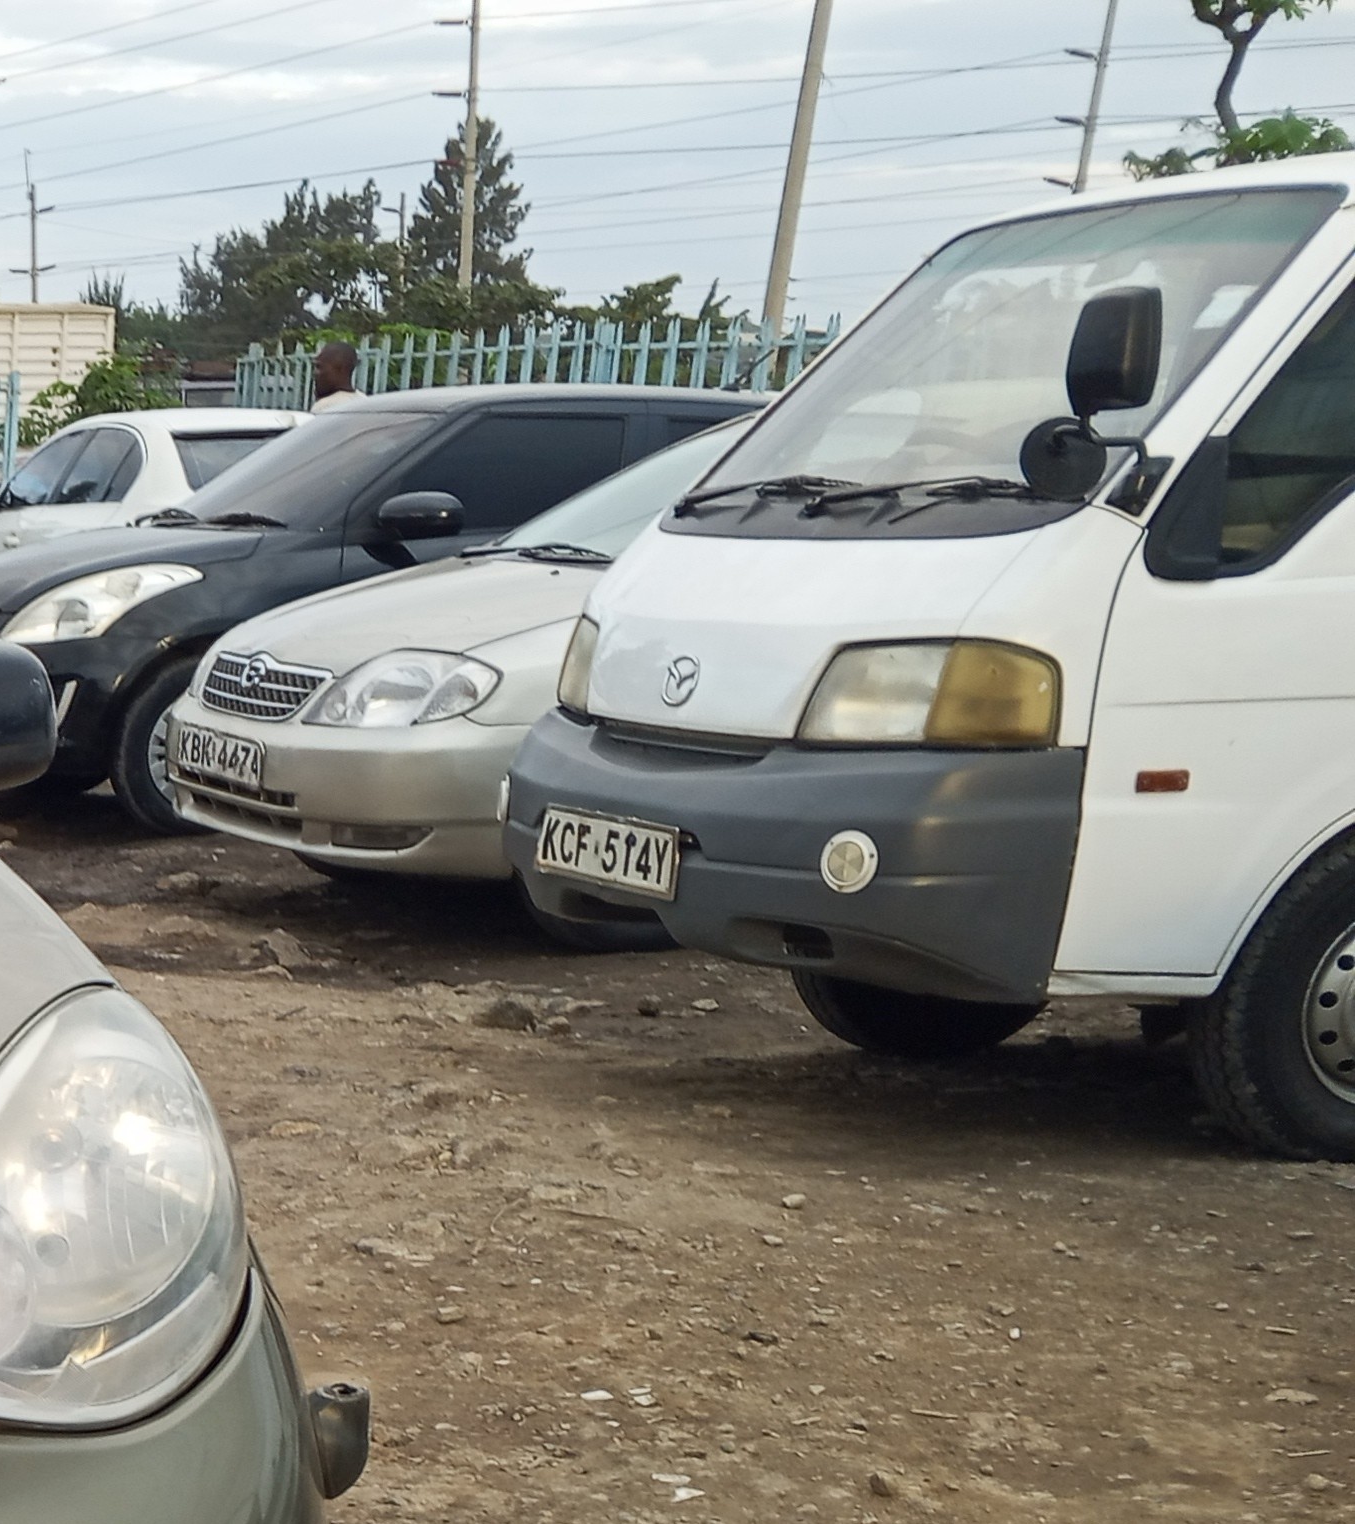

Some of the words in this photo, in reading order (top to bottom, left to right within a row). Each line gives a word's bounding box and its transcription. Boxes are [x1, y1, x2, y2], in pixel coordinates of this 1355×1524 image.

[180, 729, 213, 767] KBK
[542, 816, 591, 867] KCF
[602, 829, 669, 885] 514Y
